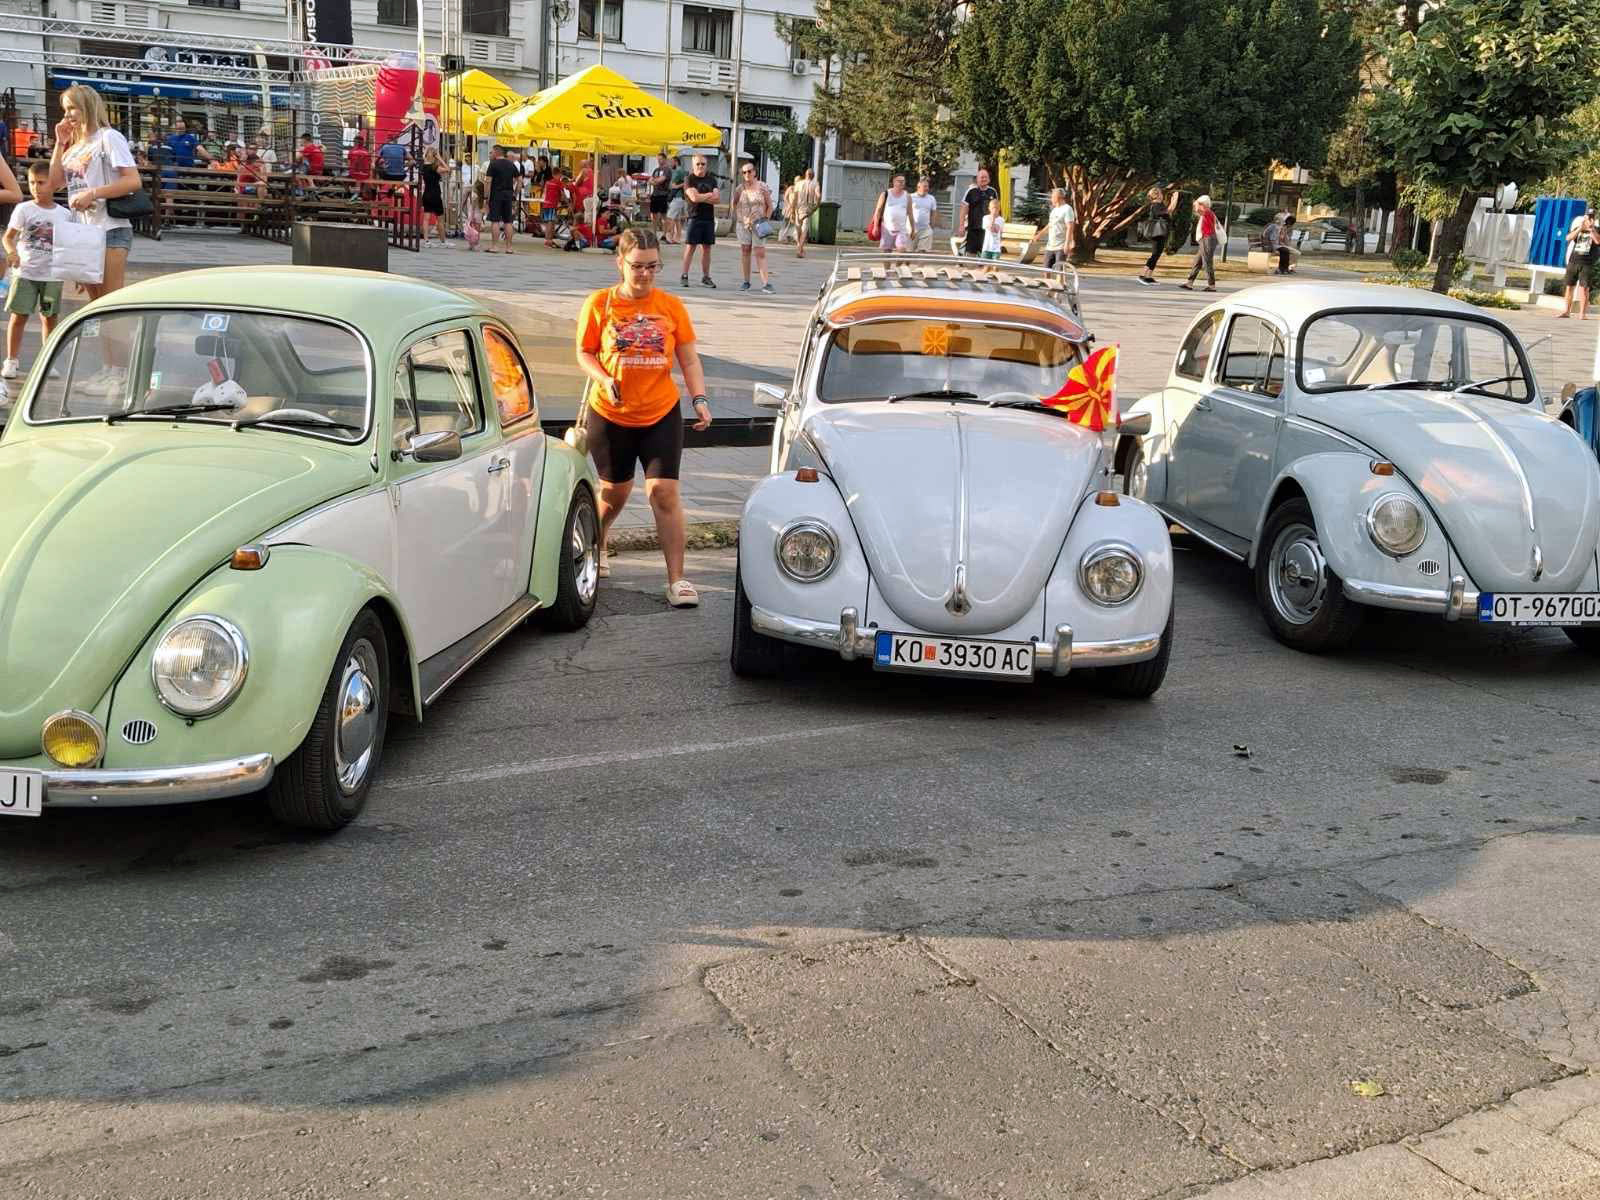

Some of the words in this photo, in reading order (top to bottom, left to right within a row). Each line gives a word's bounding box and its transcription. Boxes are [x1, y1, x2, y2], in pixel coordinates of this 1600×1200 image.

[582, 104, 654, 120] Jelen
[939, 642, 996, 669] 3930
[1002, 647, 1029, 672] AC
